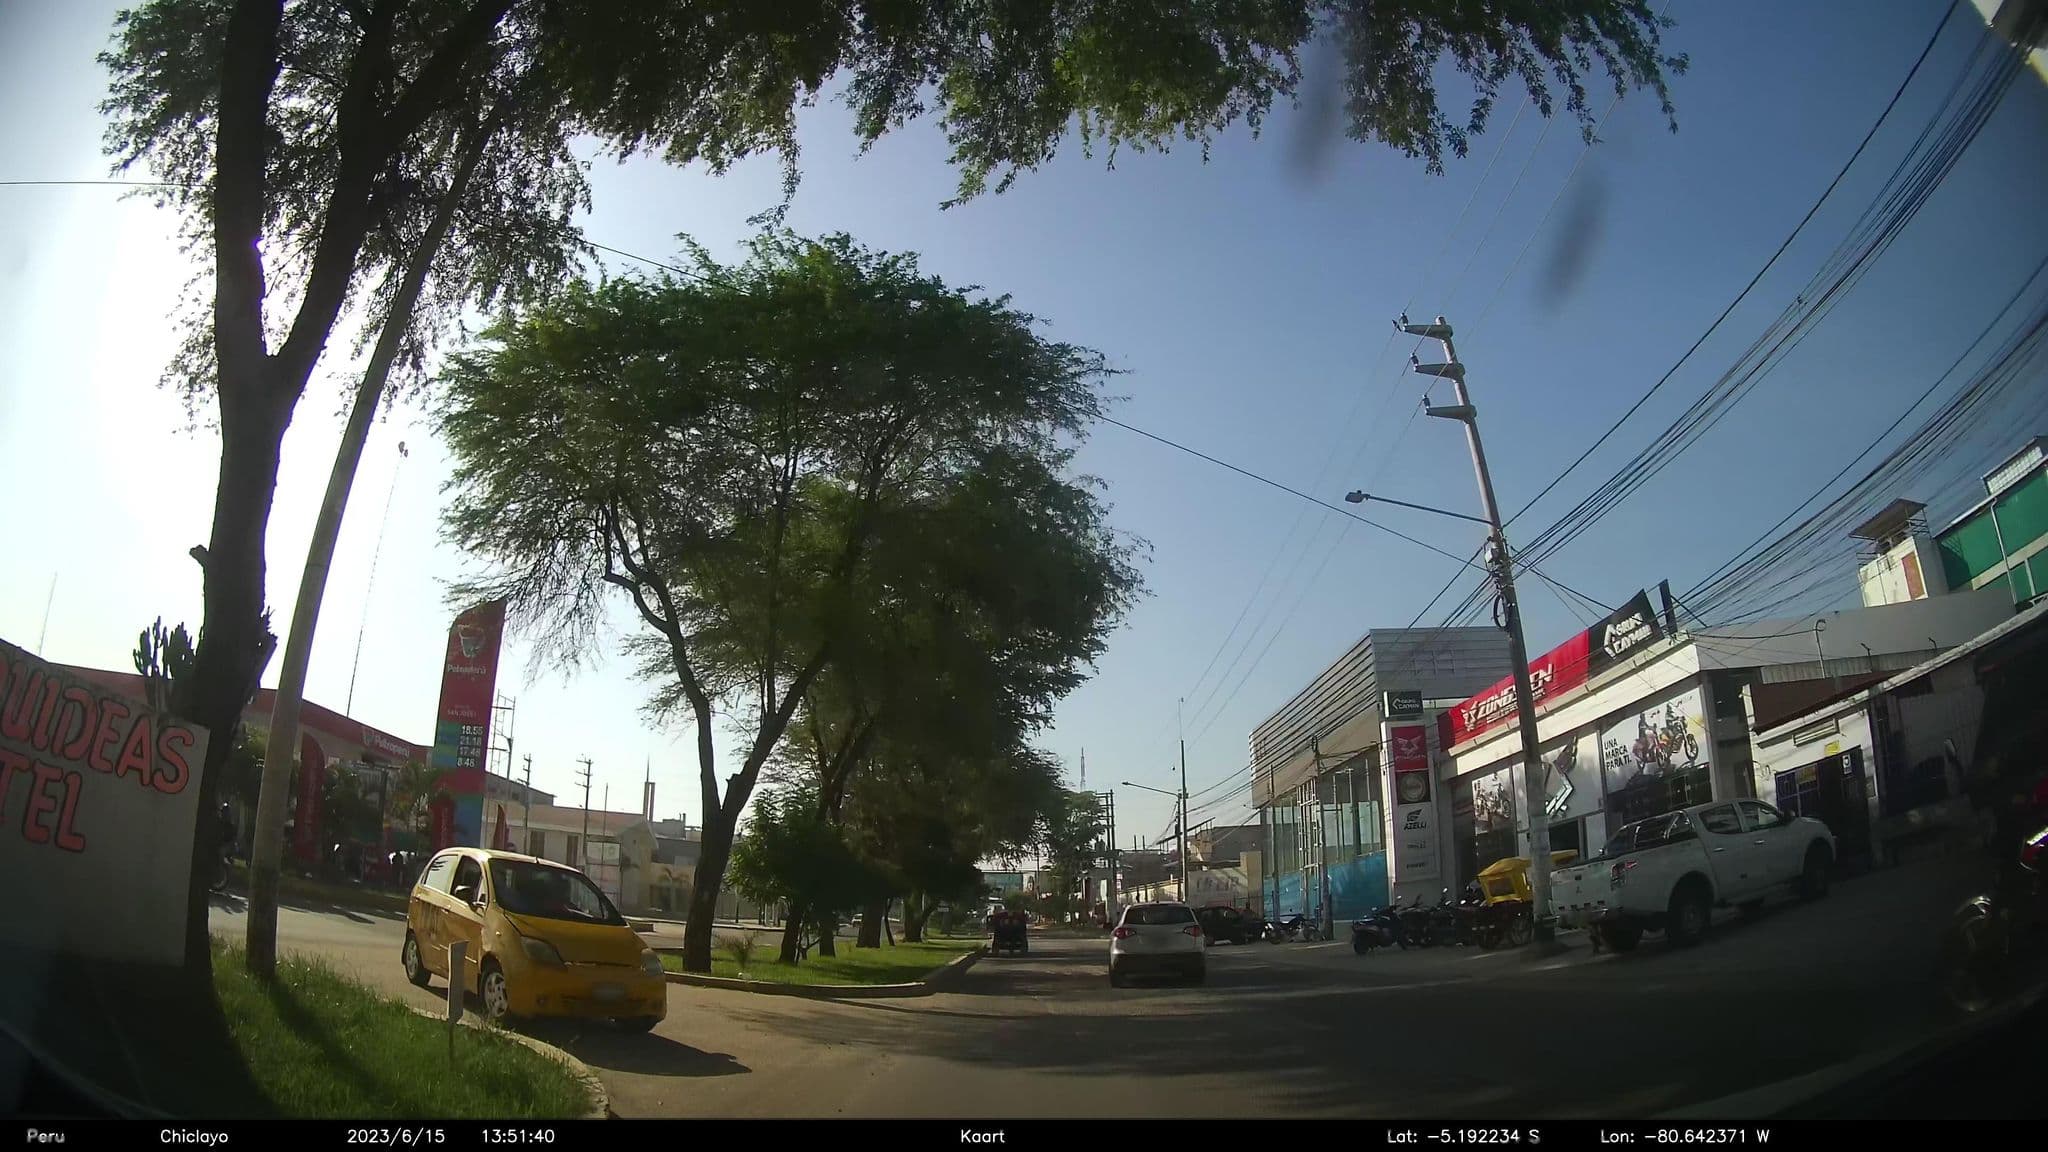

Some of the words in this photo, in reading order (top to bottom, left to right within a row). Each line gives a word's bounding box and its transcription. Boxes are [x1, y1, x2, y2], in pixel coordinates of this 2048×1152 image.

[0, 656, 195, 794] UIDEAS
[1603, 738, 1618, 751] UNA
[1605, 744, 1628, 761] MARCA
[1606, 757, 1624, 771] PARA
